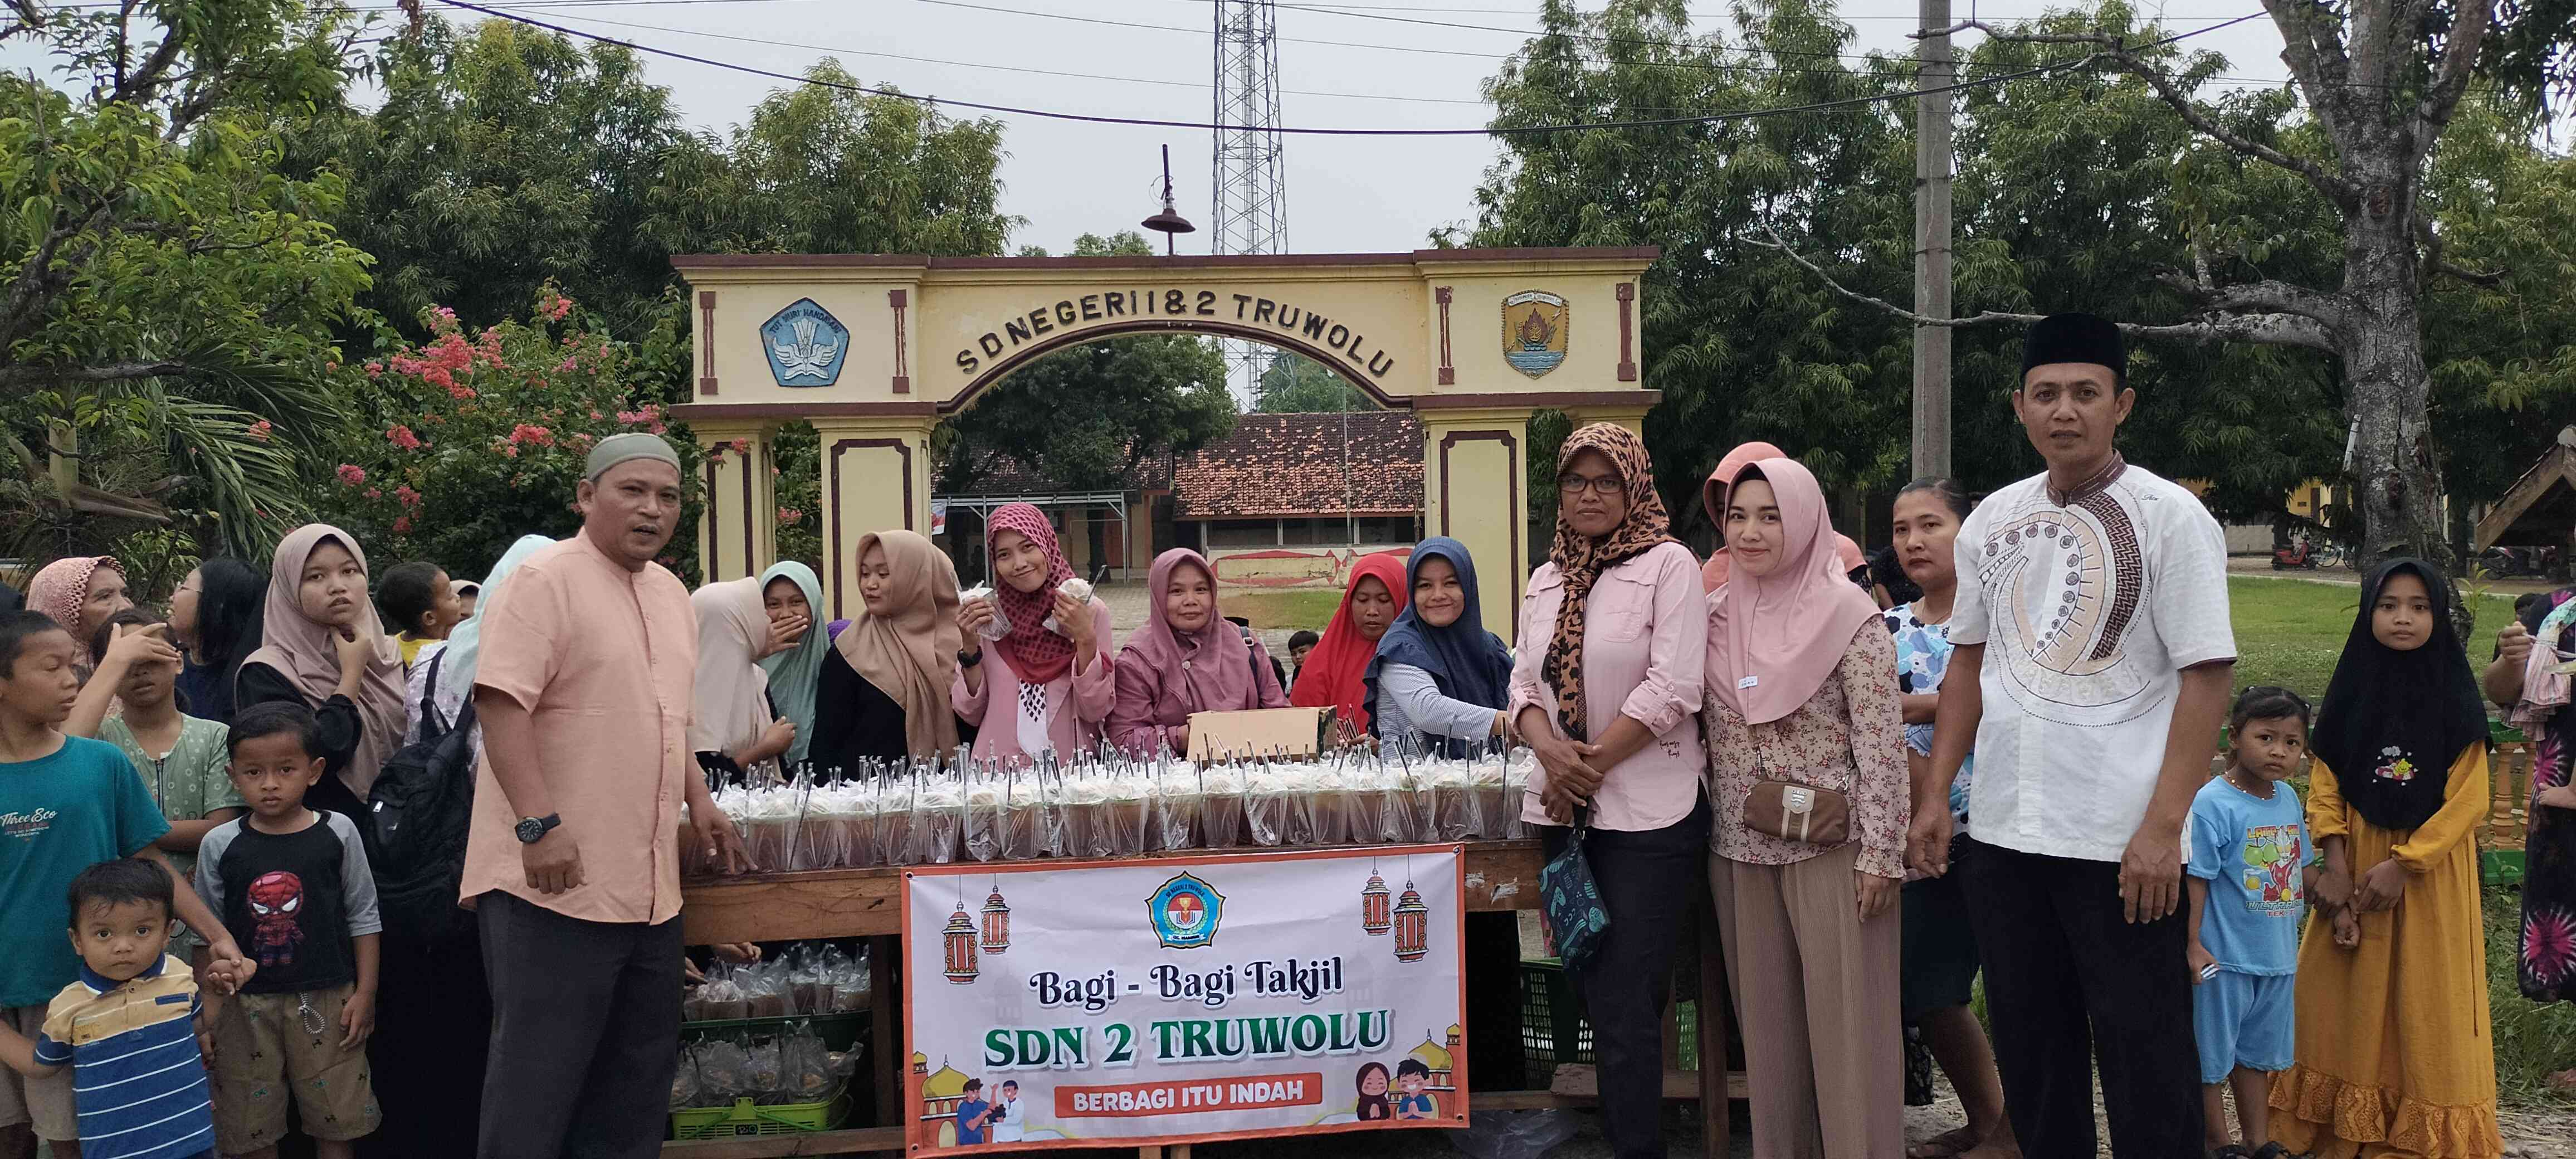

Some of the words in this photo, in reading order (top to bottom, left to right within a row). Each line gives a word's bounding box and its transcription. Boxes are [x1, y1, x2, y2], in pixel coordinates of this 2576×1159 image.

[1005, 290, 1137, 345] NEGERI
[1233, 293, 1394, 378] TRUWOLU
[1030, 970, 1115, 1011] Bagi
[1150, 965, 1234, 1006] Bagi
[1244, 957, 1342, 1000] Takjil
[984, 1027, 1085, 1067] SDN
[1104, 1023, 1134, 1063] 2
[1150, 1010, 1388, 1059] TRUWOLU
[1073, 1088, 1174, 1111] BERBAGI
[1182, 1085, 1222, 1107] ITU
[1230, 1080, 1304, 1104] INDAH
